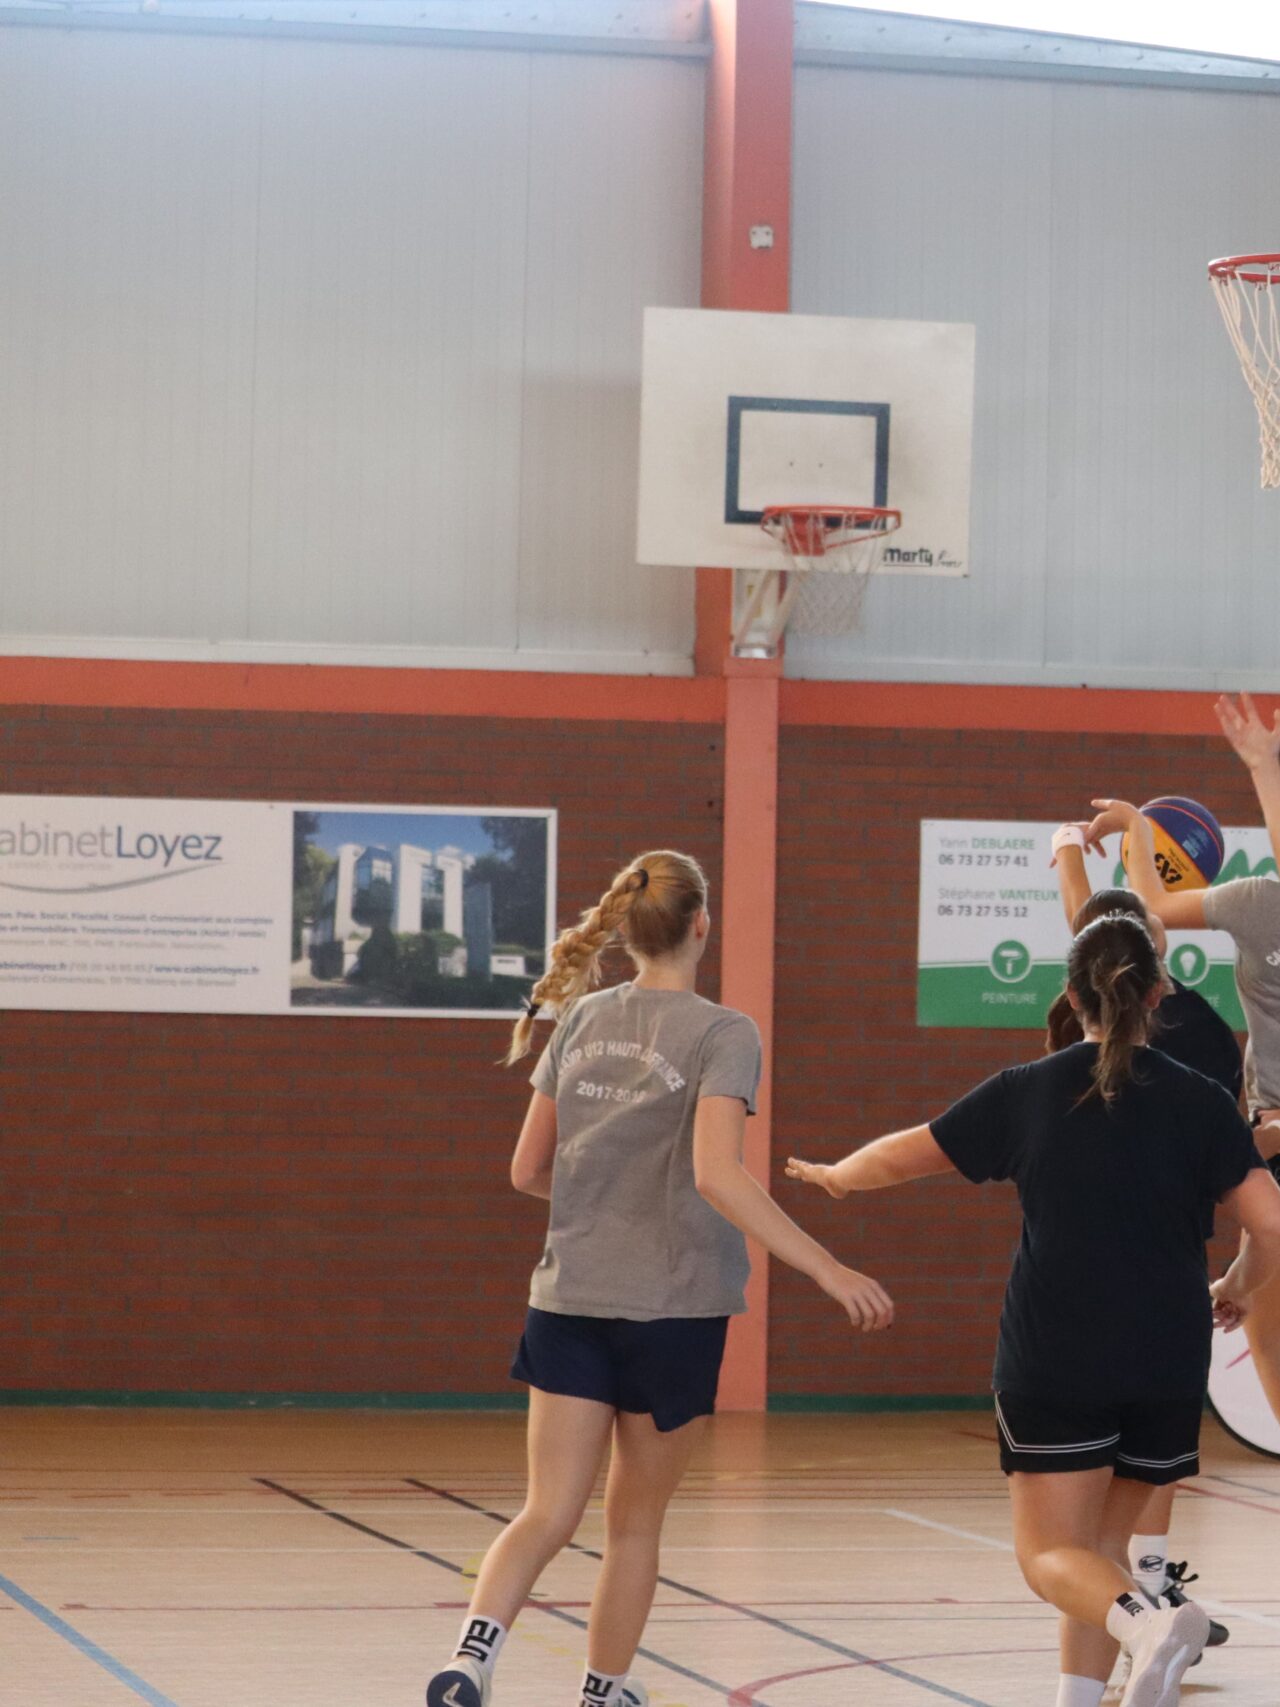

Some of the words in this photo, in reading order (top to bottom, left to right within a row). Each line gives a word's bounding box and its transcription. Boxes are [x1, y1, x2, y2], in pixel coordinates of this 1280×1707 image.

[939, 838, 968, 849] Yann
[939, 854, 954, 865] 06
[958, 855, 973, 866] 73
[977, 855, 991, 866] 27
[995, 856, 1010, 866] 57
[1014, 856, 1028, 867] 41
[938, 905, 953, 916] 06
[958, 905, 972, 916] 73
[976, 906, 991, 917] 27
[995, 906, 1009, 917] 55
[1014, 907, 1028, 918] 12
[584, 1041, 604, 1059] U12
